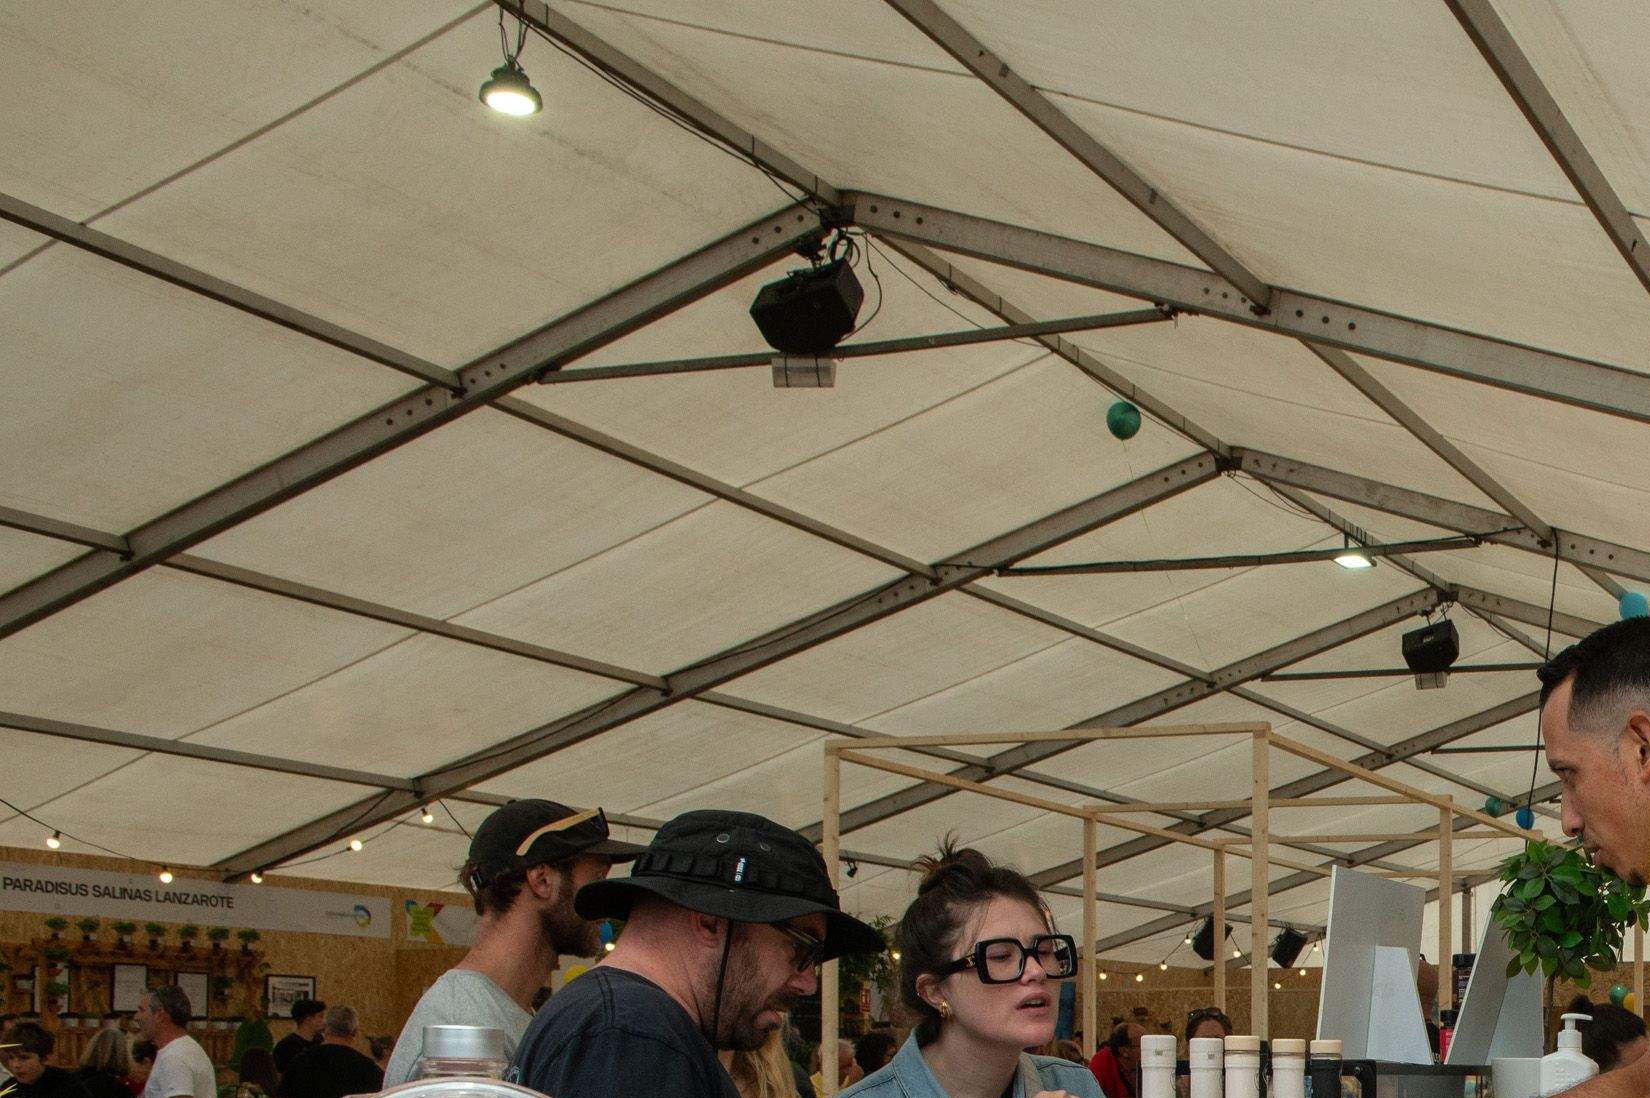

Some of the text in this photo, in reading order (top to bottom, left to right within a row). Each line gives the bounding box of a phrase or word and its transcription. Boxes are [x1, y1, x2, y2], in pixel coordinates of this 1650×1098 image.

[2, 876, 235, 909] PARADISUS SALINAS LANZAROTE
